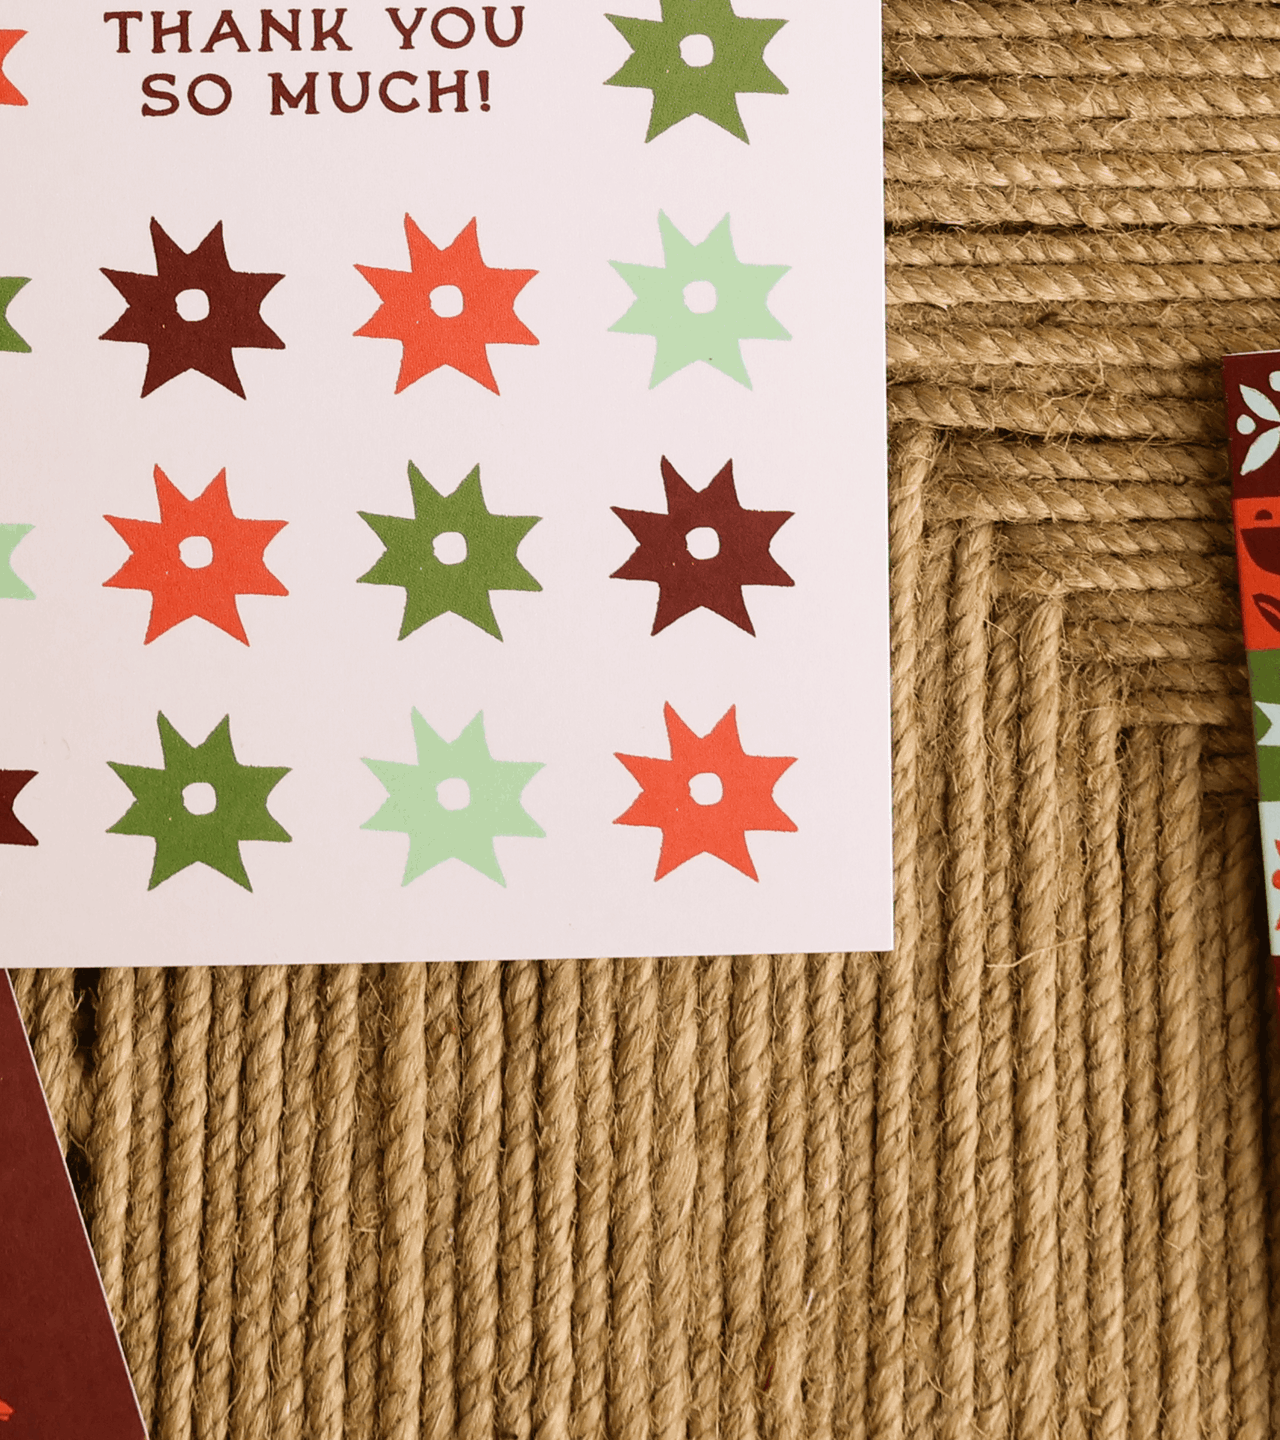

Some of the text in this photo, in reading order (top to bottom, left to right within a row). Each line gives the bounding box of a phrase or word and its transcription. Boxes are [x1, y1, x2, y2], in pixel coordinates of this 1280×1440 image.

[103, 5, 526, 54] THANK YOU
[141, 69, 491, 117] SO MUCH!
